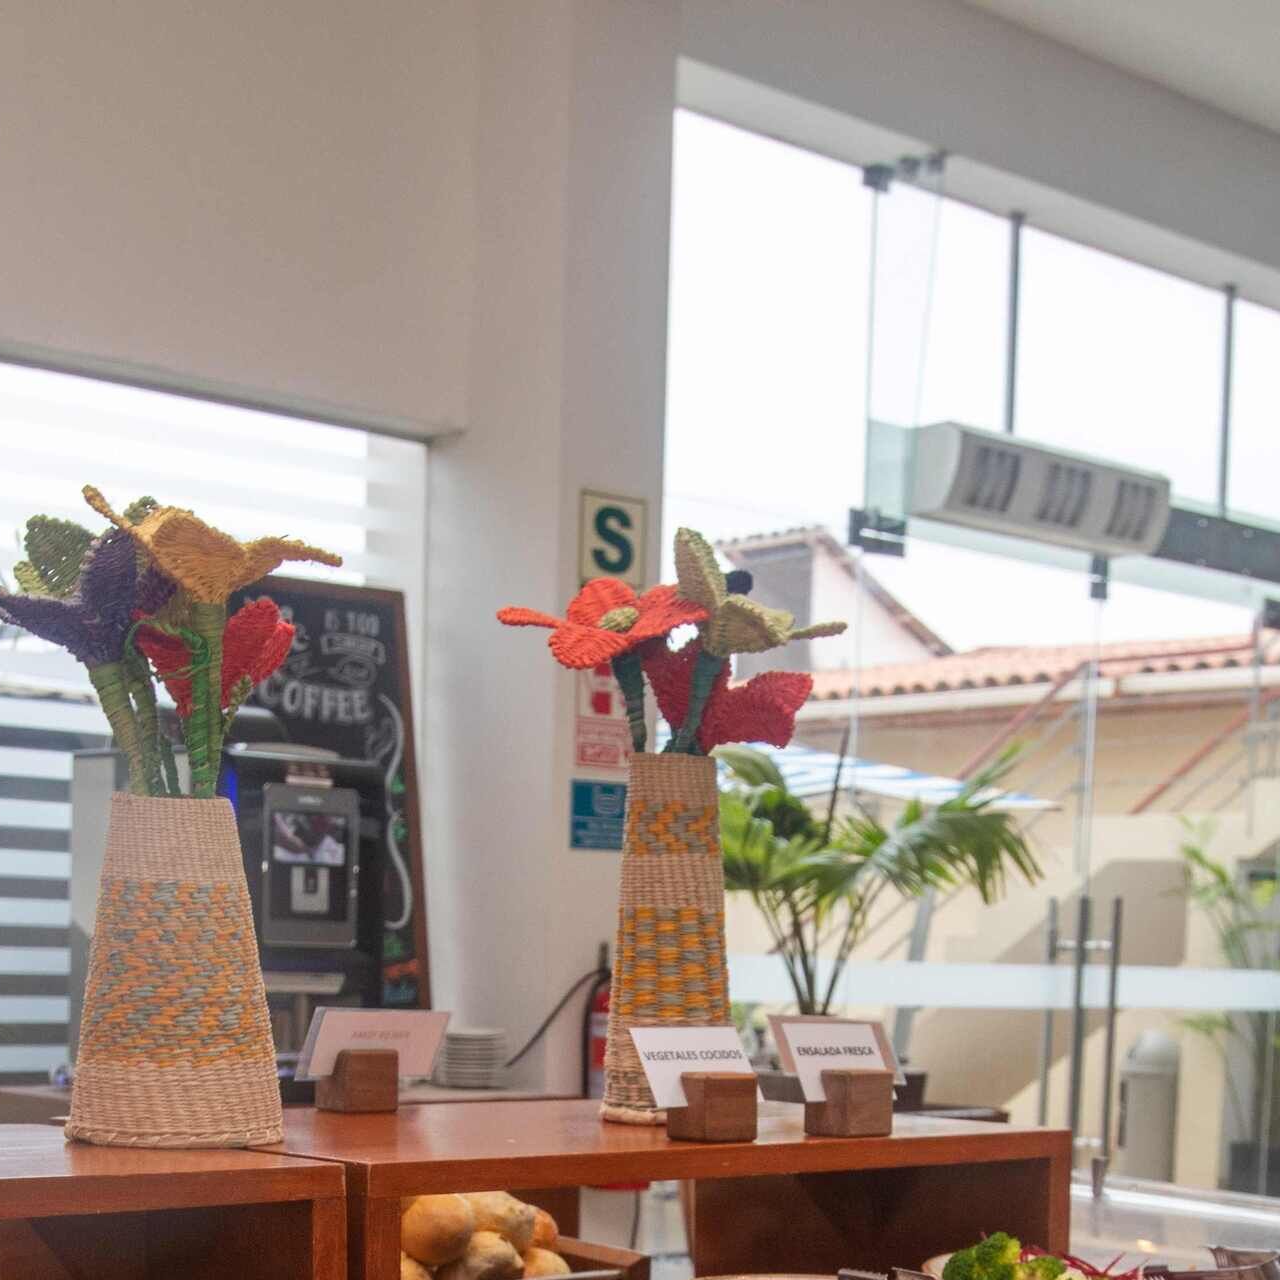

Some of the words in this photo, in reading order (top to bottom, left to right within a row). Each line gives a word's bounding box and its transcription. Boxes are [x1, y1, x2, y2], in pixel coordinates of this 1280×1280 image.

[592, 506, 632, 574] S
[642, 1050, 699, 1062] VEGETALES
[700, 1048, 743, 1060] COCIDOS
[797, 1046, 843, 1057] ENSALADA
[844, 1046, 875, 1057] FRESCA
